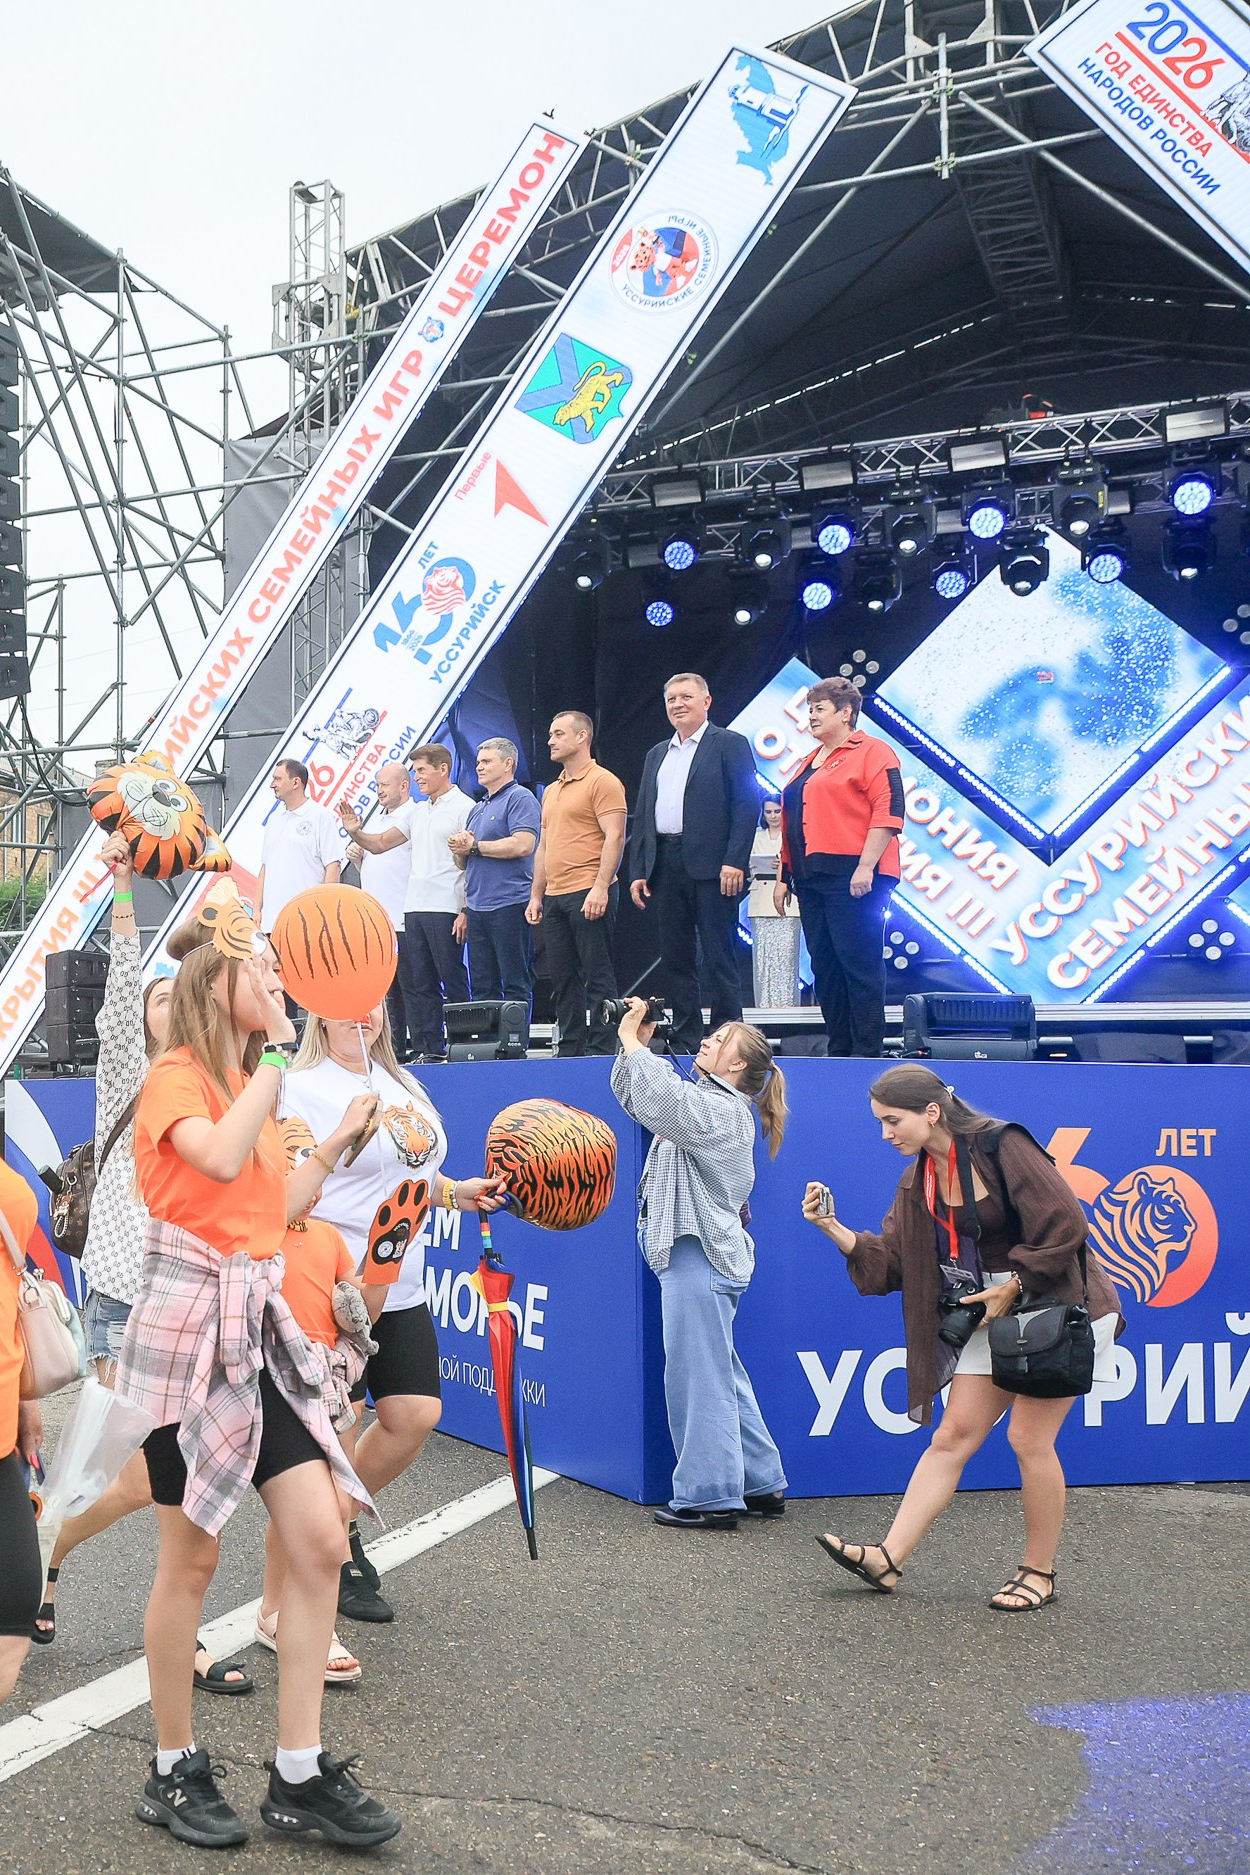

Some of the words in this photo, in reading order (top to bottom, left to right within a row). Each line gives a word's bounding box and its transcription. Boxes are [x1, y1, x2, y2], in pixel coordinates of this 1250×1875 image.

[1126, 2, 1226, 90] 2026
[1077, 57, 1154, 131] НАРОДОВ
[1150, 128, 1222, 196] РОССИИ
[1095, 42, 1132, 79] ГОД
[1128, 73, 1213, 158] ЕДИНСТВА
[437, 133, 566, 317] ЦЕРЕМОН
[247, 424, 382, 624] СЕМЕЙНЫХ
[372, 349, 424, 422] ИГР
[454, 451, 492, 501] Первые
[417, 541, 440, 570] ЛЕТ
[429, 579, 506, 685] УССУРИЙСК
[307, 761, 336, 803] 26
[333, 743, 387, 822] ДИНСТВА
[367, 725, 416, 793] РСИИ
[1155, 1128, 1217, 1157] ЛЕТ
